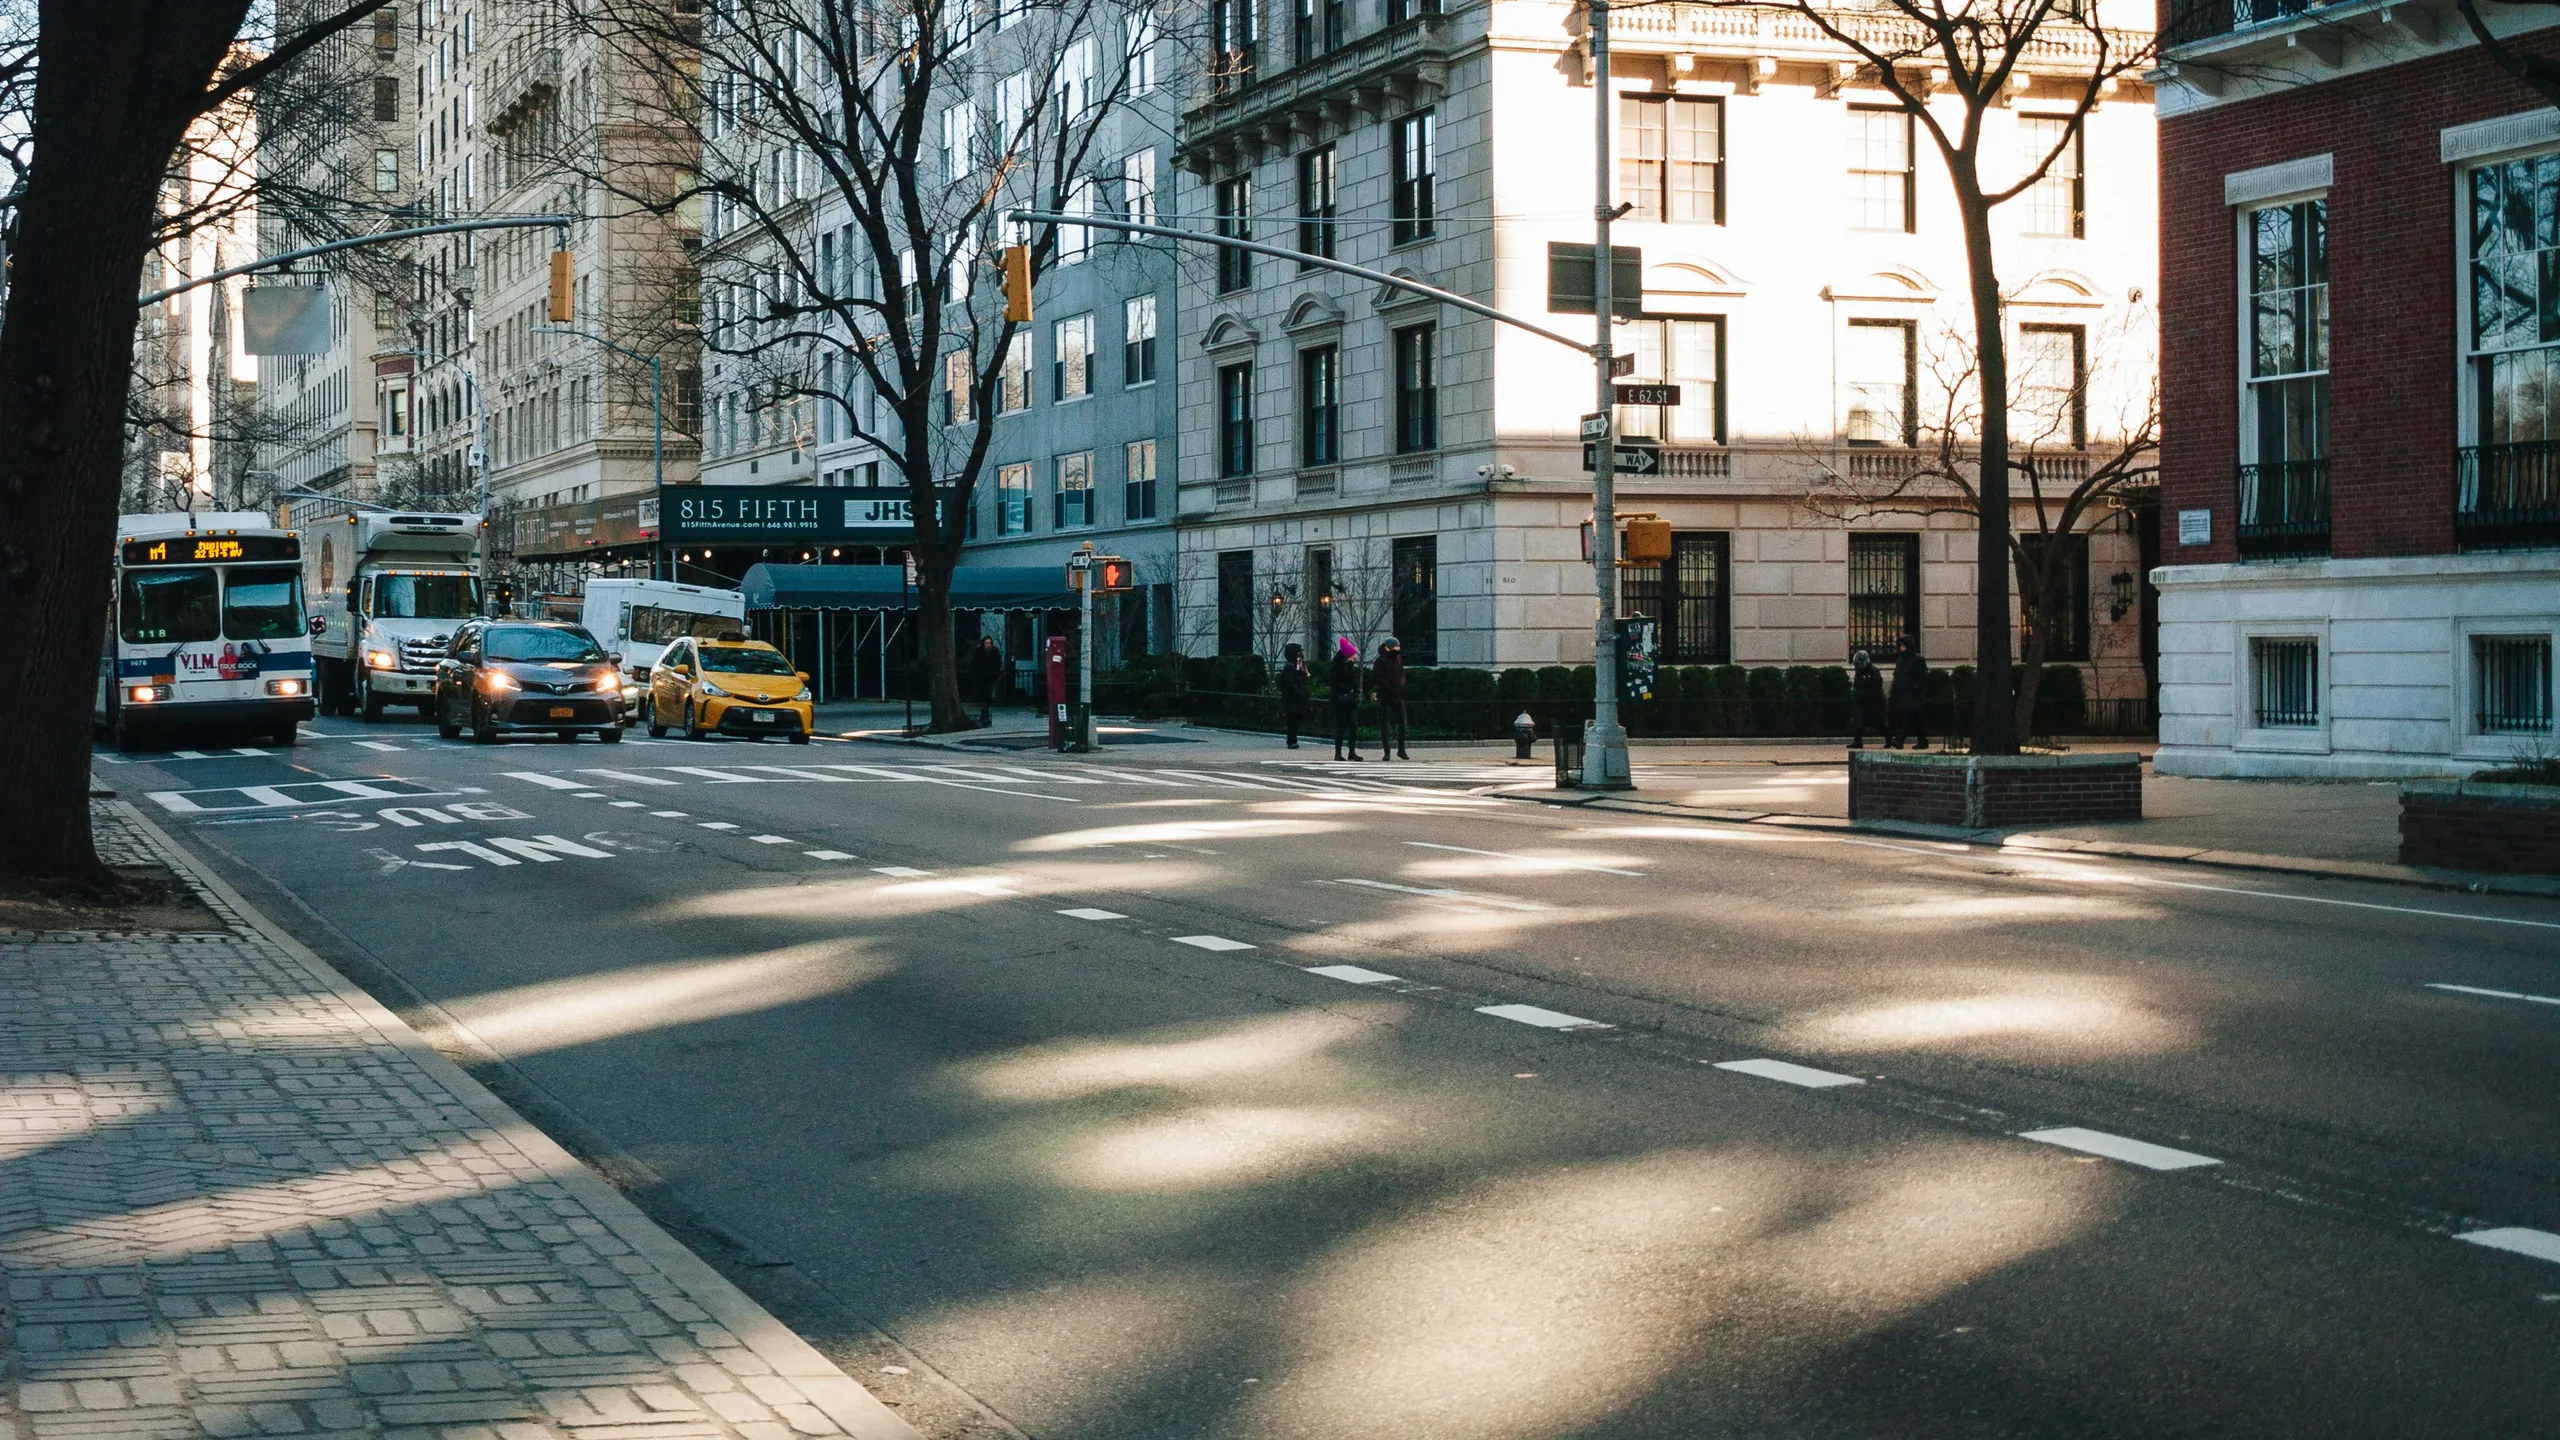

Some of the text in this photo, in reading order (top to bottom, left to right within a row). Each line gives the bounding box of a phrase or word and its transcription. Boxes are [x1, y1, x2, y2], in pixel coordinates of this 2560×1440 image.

[1628, 389, 1668, 404] E 62 St
[1584, 421, 1593, 434] ONE
[1626, 454, 1648, 465] WAY
[680, 499, 724, 519] 815
[739, 499, 818, 519] FIFTH
[865, 501, 914, 521] JHS
[681, 521, 818, 529] 815FifthAvenue.com 646.981.9915
[150, 542, 166, 560] M4
[194, 549, 207, 559] 32
[180, 653, 218, 670] V.I.M.
[302, 801, 538, 832] BUS
